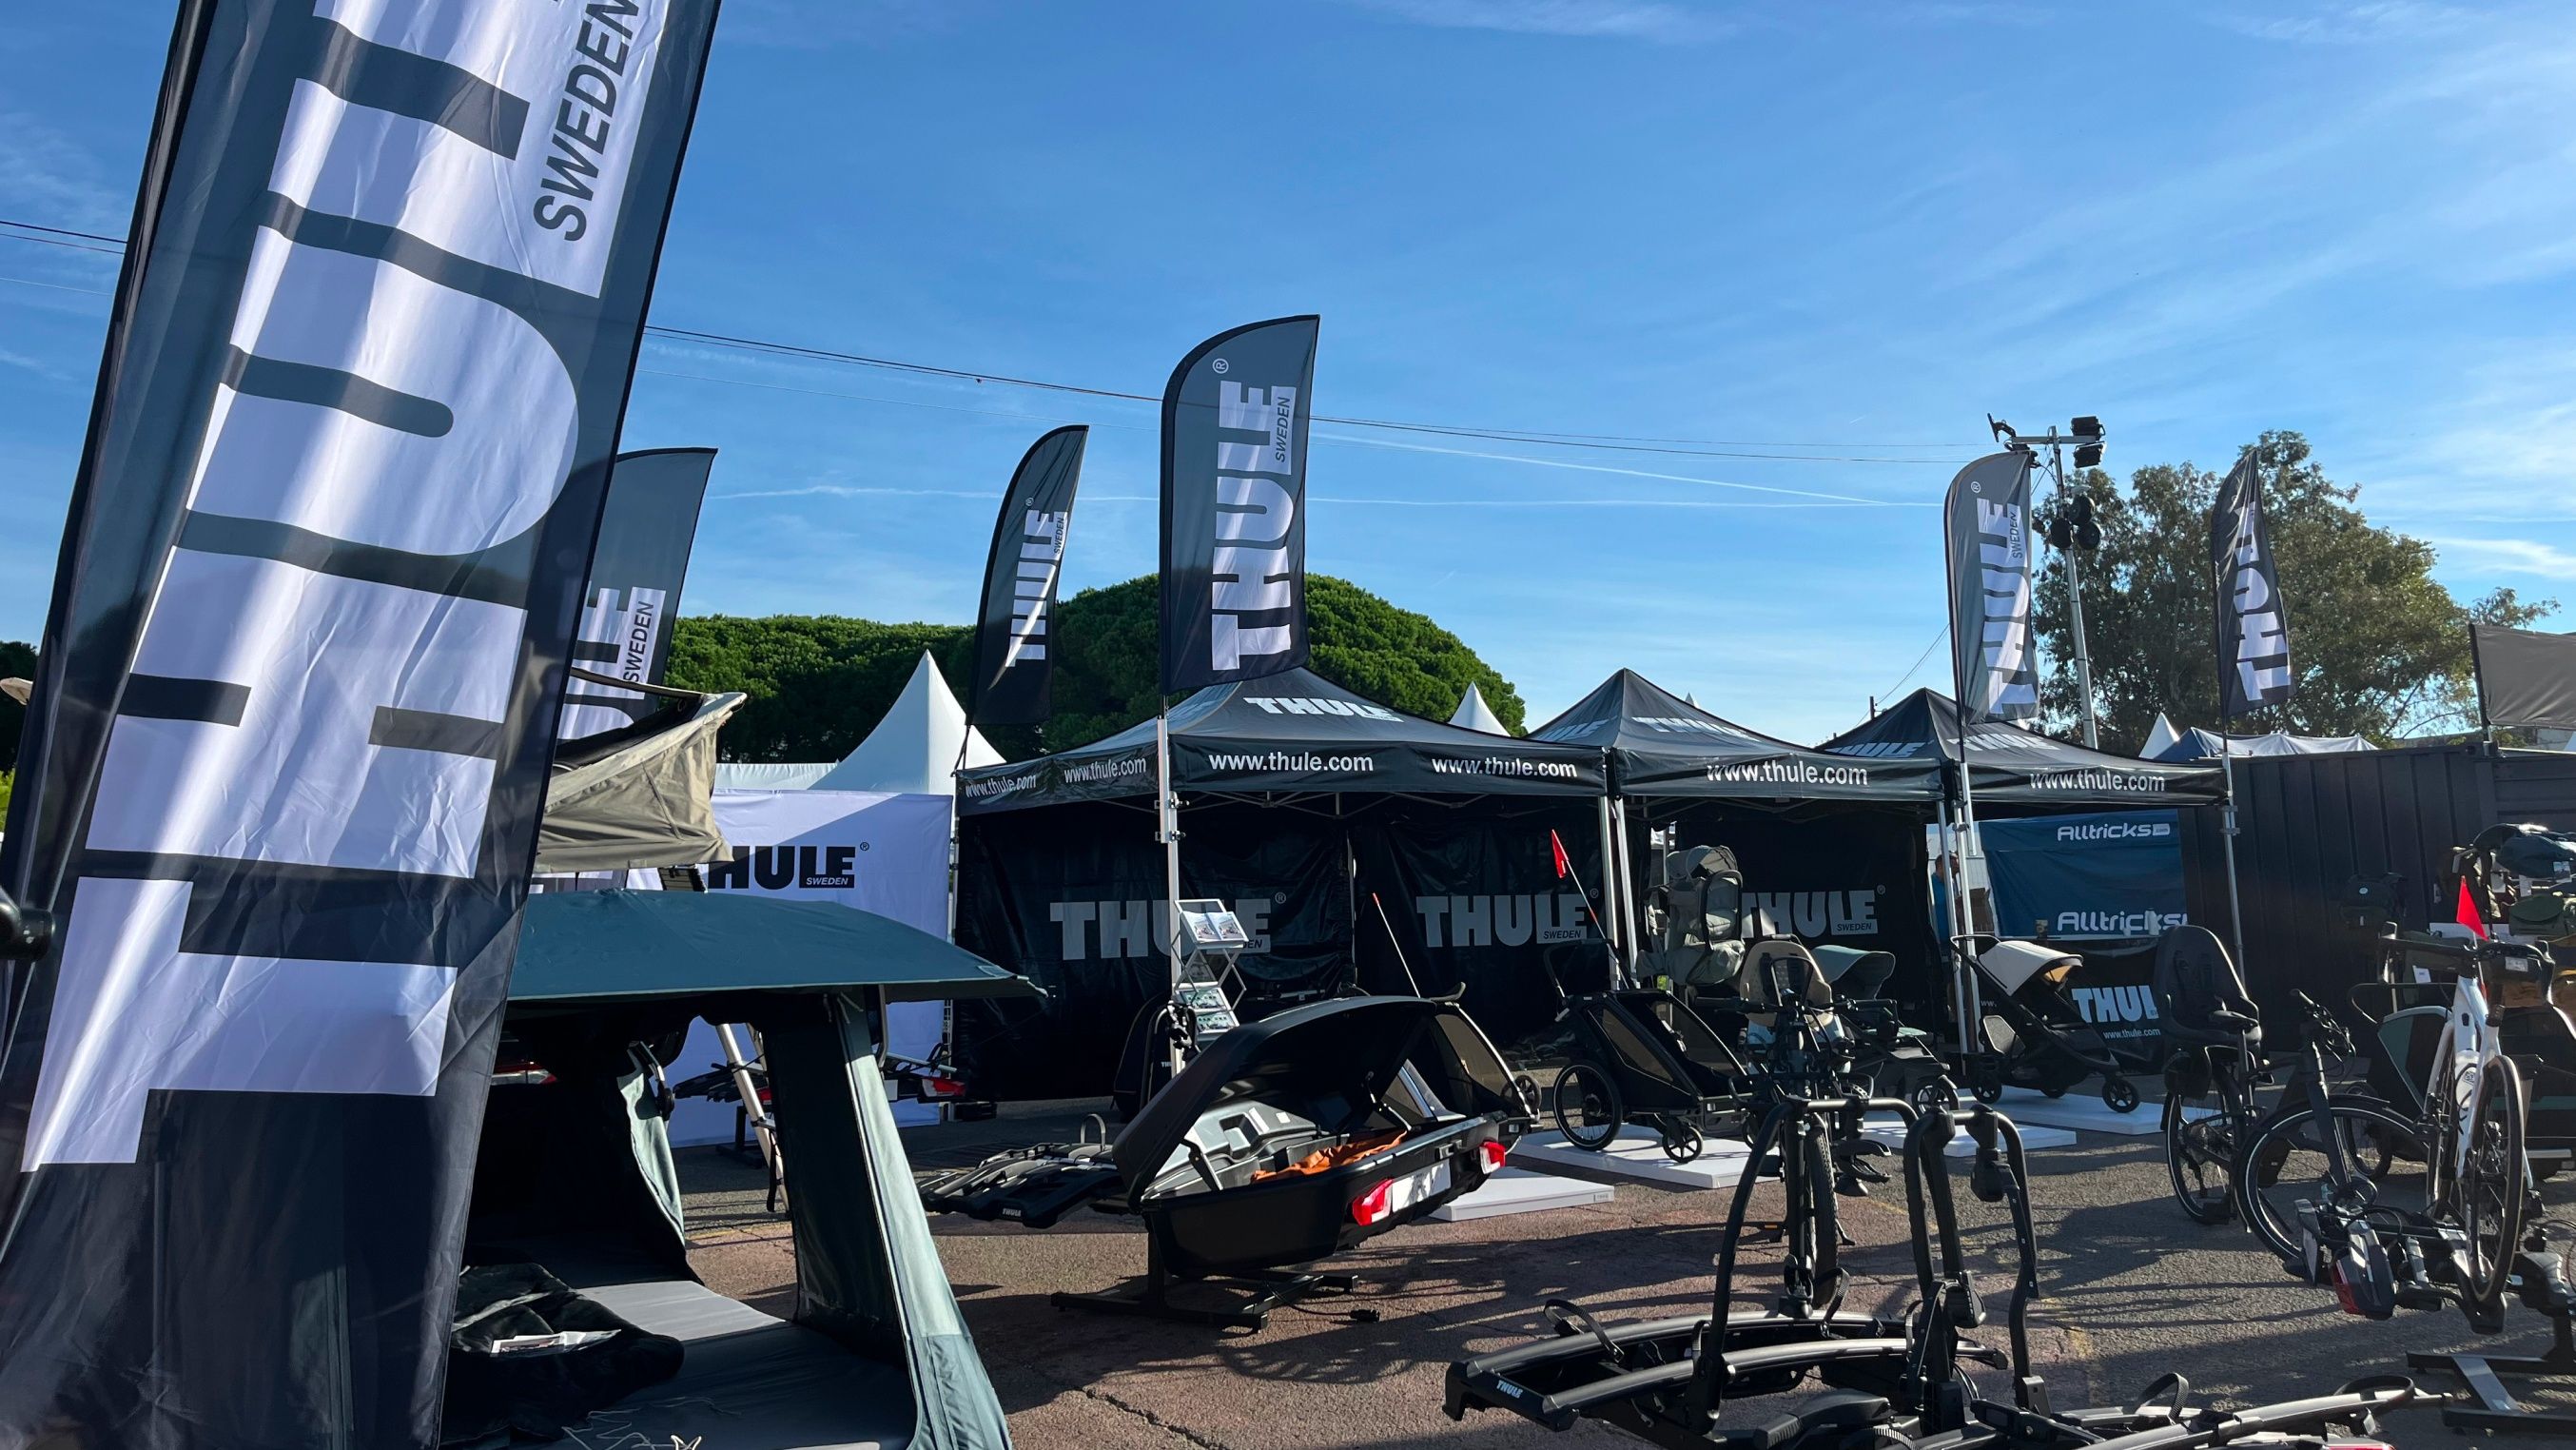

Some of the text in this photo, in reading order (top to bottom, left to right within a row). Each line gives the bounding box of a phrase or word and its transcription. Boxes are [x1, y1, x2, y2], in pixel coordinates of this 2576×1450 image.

[1275, 397, 1290, 462] SWEDEN
[1054, 517, 1064, 554] SWEDEN
[1211, 380, 1297, 670] THULE
[2009, 511, 2023, 558] SWEDEN
[1976, 498, 2037, 714] THULE
[623, 600, 654, 684] SWEDEN
[1243, 696, 1405, 723] THULE
[1064, 757, 1146, 783] www.thule.com
[1208, 751, 1374, 772] www.thule.com
[1432, 756, 1578, 777] www.thule.com
[1707, 760, 1868, 786] www.thule.com
[966, 774, 1037, 798] www.thule.com
[2030, 769, 2165, 792] www.thule.com
[2057, 822, 2152, 841] Alltricks
[706, 845, 856, 890] HULE
[806, 876, 849, 886] SWEDEN
[1415, 893, 1588, 948] THULE
[1837, 922, 1872, 931] SWEDEN
[1543, 930, 1581, 939] SWEDEN
[2071, 985, 2158, 1024] THUL
[2102, 1028, 2161, 1039] www.thule.com
[1496, 1380, 1524, 1399] THULE
